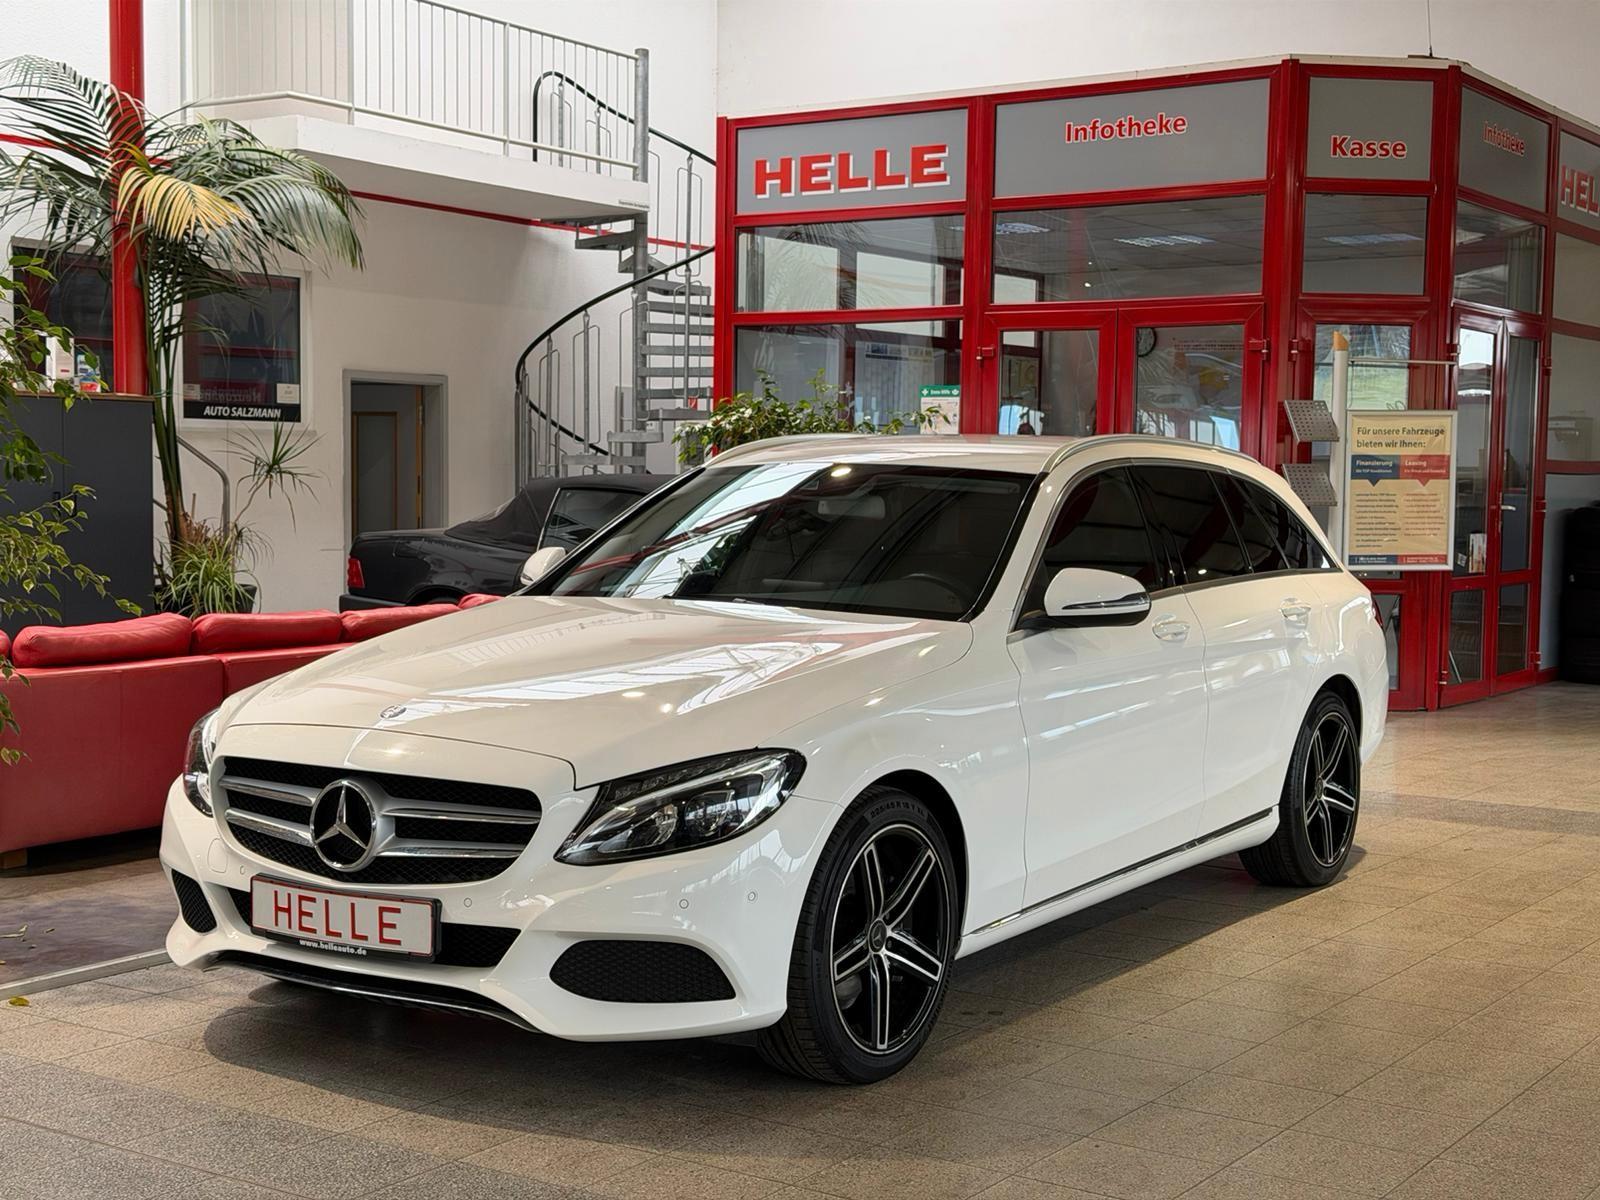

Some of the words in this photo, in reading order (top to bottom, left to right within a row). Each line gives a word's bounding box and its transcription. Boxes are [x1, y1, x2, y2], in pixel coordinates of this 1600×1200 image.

[1065, 112, 1188, 144] Infotheke
[1483, 121, 1525, 157] Infotheke
[1330, 134, 1407, 159] Kasse
[754, 143, 950, 199] HELLE
[203, 405, 230, 416] AUTO
[230, 406, 281, 418] SALZMANN
[1356, 439, 1383, 448] bieten
[1385, 439, 1397, 448] wir
[1400, 439, 1426, 448] Ihnen:
[1357, 426, 1371, 435] Für
[1402, 426, 1445, 437] Fahrzeuge
[273, 890, 402, 946] HELLE
[299, 939, 368, 956] www.helleauto.de
